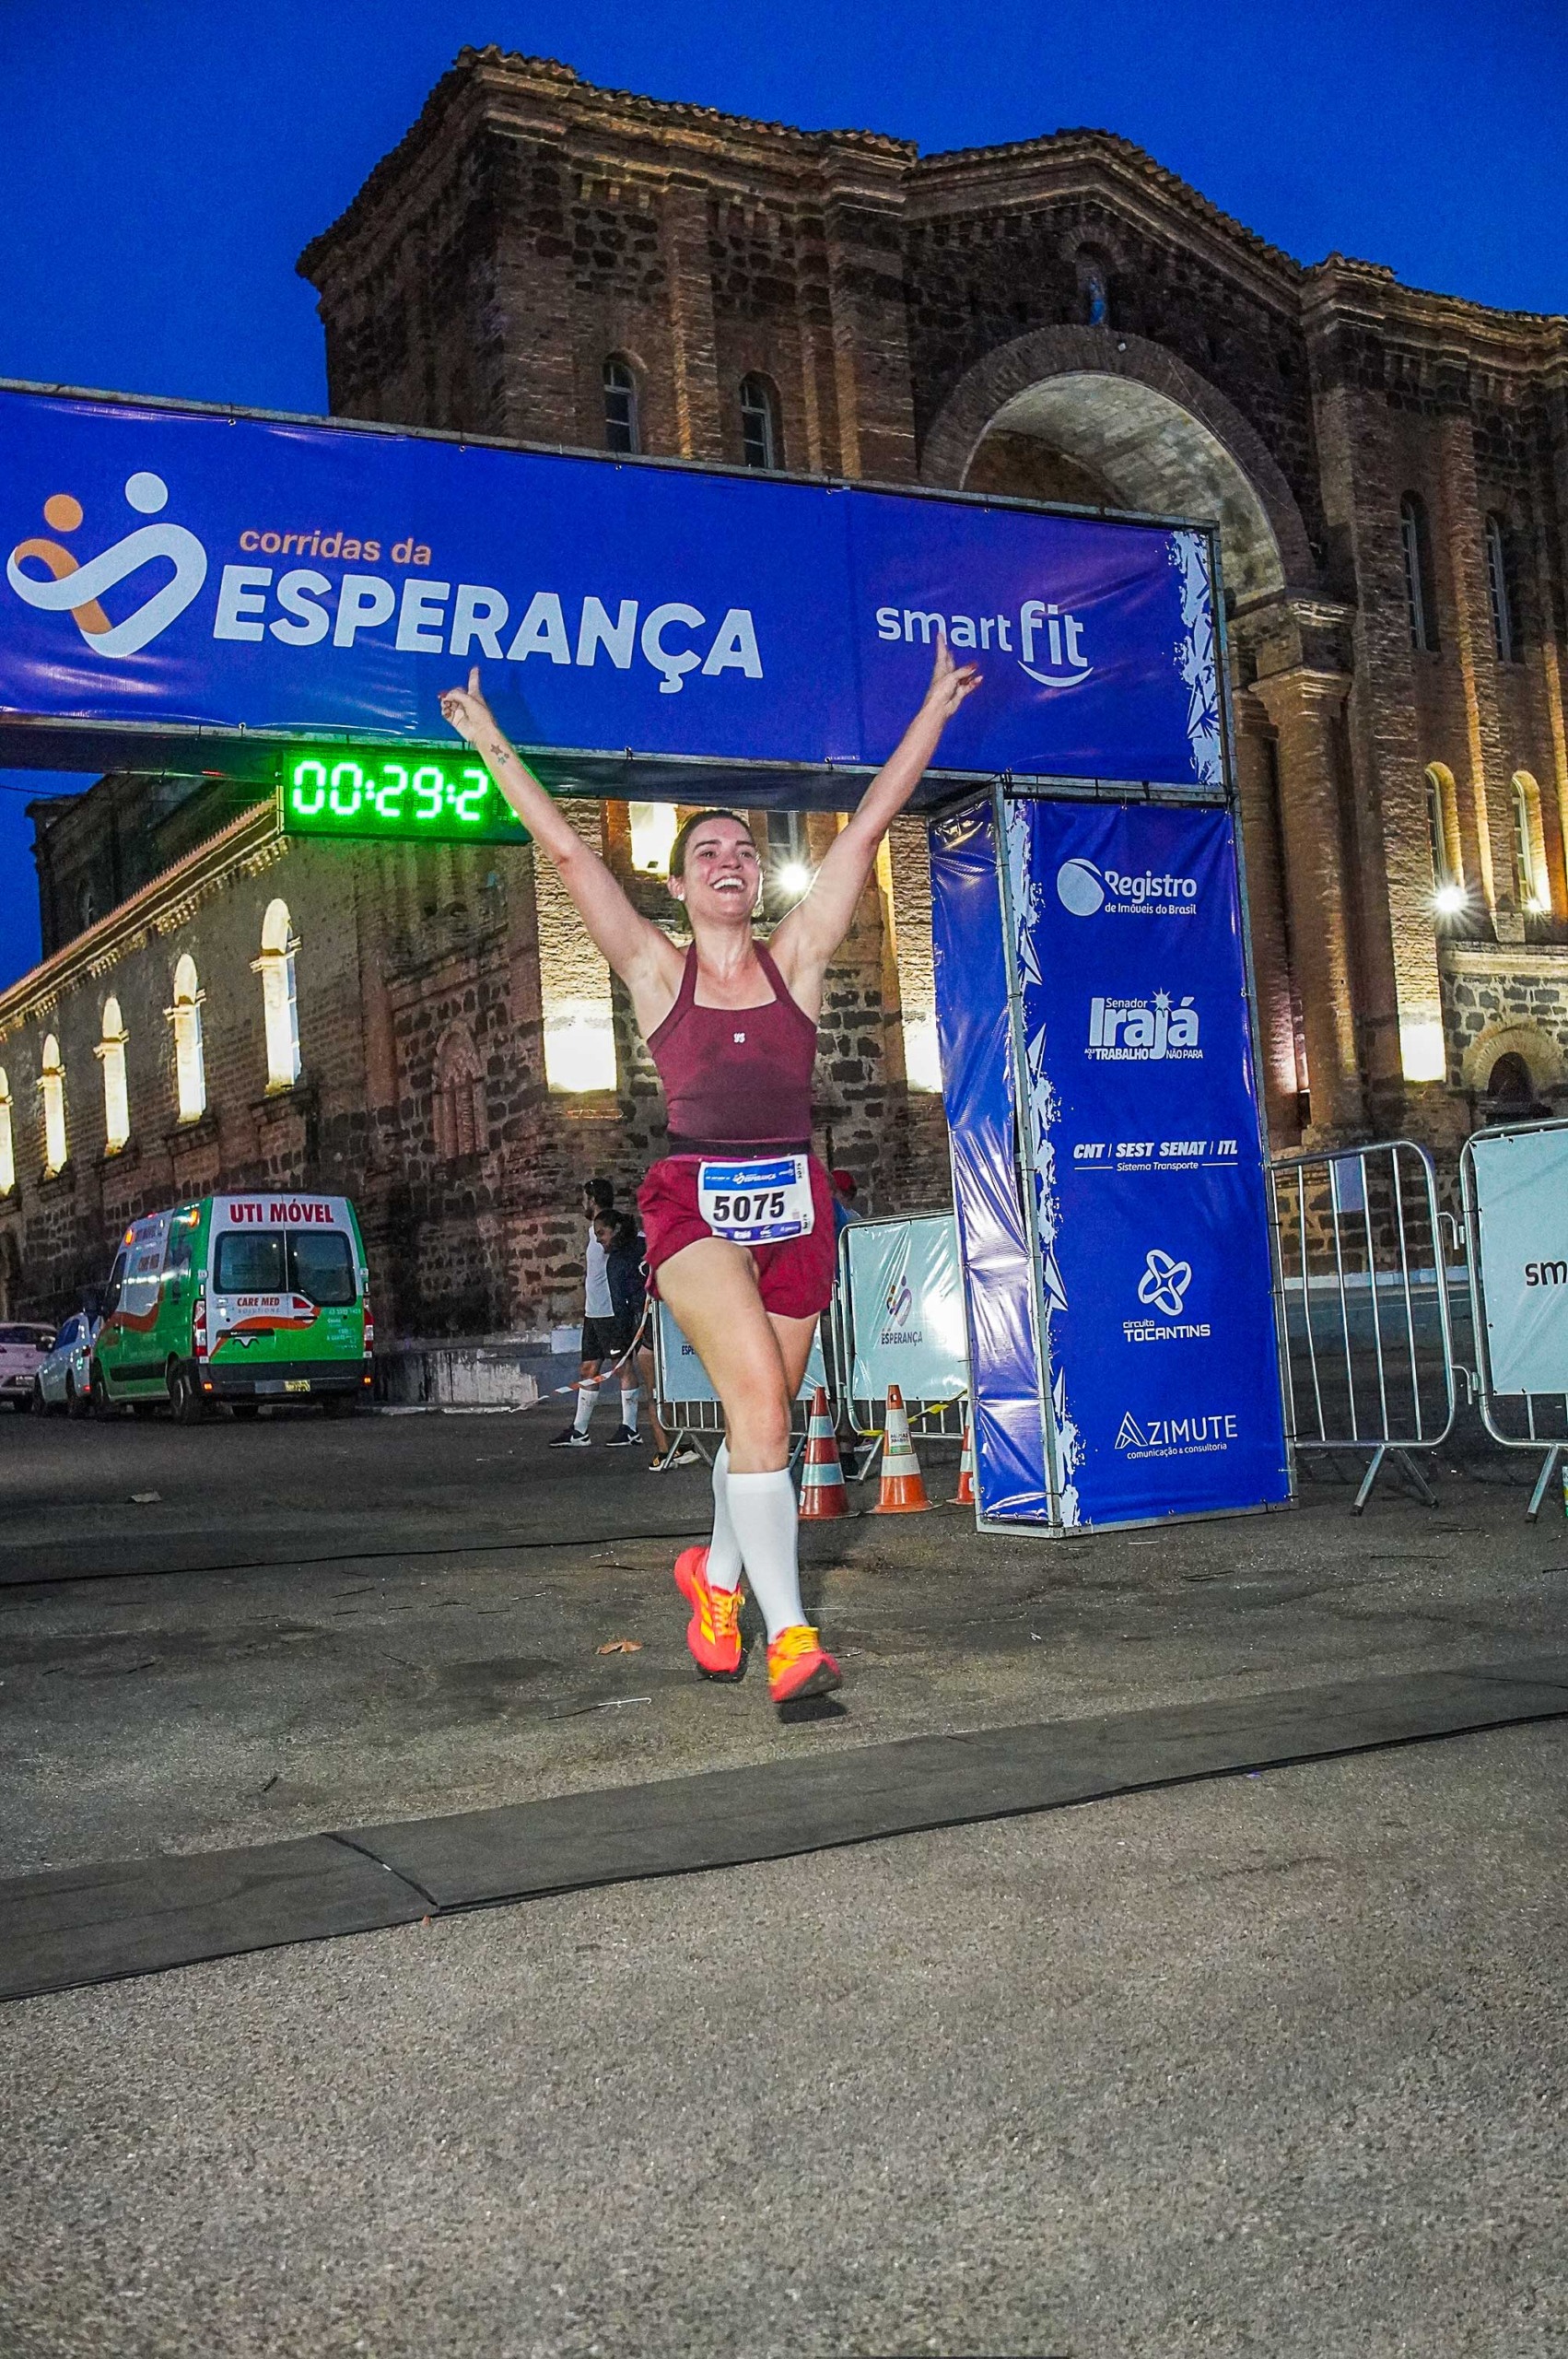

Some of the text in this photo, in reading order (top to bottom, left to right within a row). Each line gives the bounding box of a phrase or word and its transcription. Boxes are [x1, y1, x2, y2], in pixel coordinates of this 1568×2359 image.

[239, 526, 433, 567] corridas da
[212, 563, 765, 695] ESPERANÇA
[875, 599, 1089, 668] smart fit
[292, 760, 520, 822] 00:29:2
[1104, 870, 1197, 904] Registro
[1105, 902, 1117, 913] de
[1155, 904, 1167, 915] do
[1168, 904, 1197, 915] Brasil
[1106, 998, 1148, 1009] Senador
[1089, 995, 1199, 1060] Irajá
[1095, 1048, 1204, 1061] TRABALHO NÃO PARA
[1073, 1140, 1238, 1159] CNT SEST SENAT ITL
[1117, 1160, 1199, 1172] Sistema Transporte
[230, 1198, 334, 1224] UTI MÓVEL
[712, 1191, 785, 1223] 5075
[237, 1297, 280, 1308] CARE MED
[1122, 1319, 1155, 1329] circuito
[1123, 1323, 1211, 1343] TOCANTINS
[881, 1332, 923, 1346] ESPERANÇA
[1114, 1411, 1238, 1449] AZIMUTE
[1127, 1446, 1178, 1460] comunicação
[1184, 1441, 1228, 1454] consultoria
